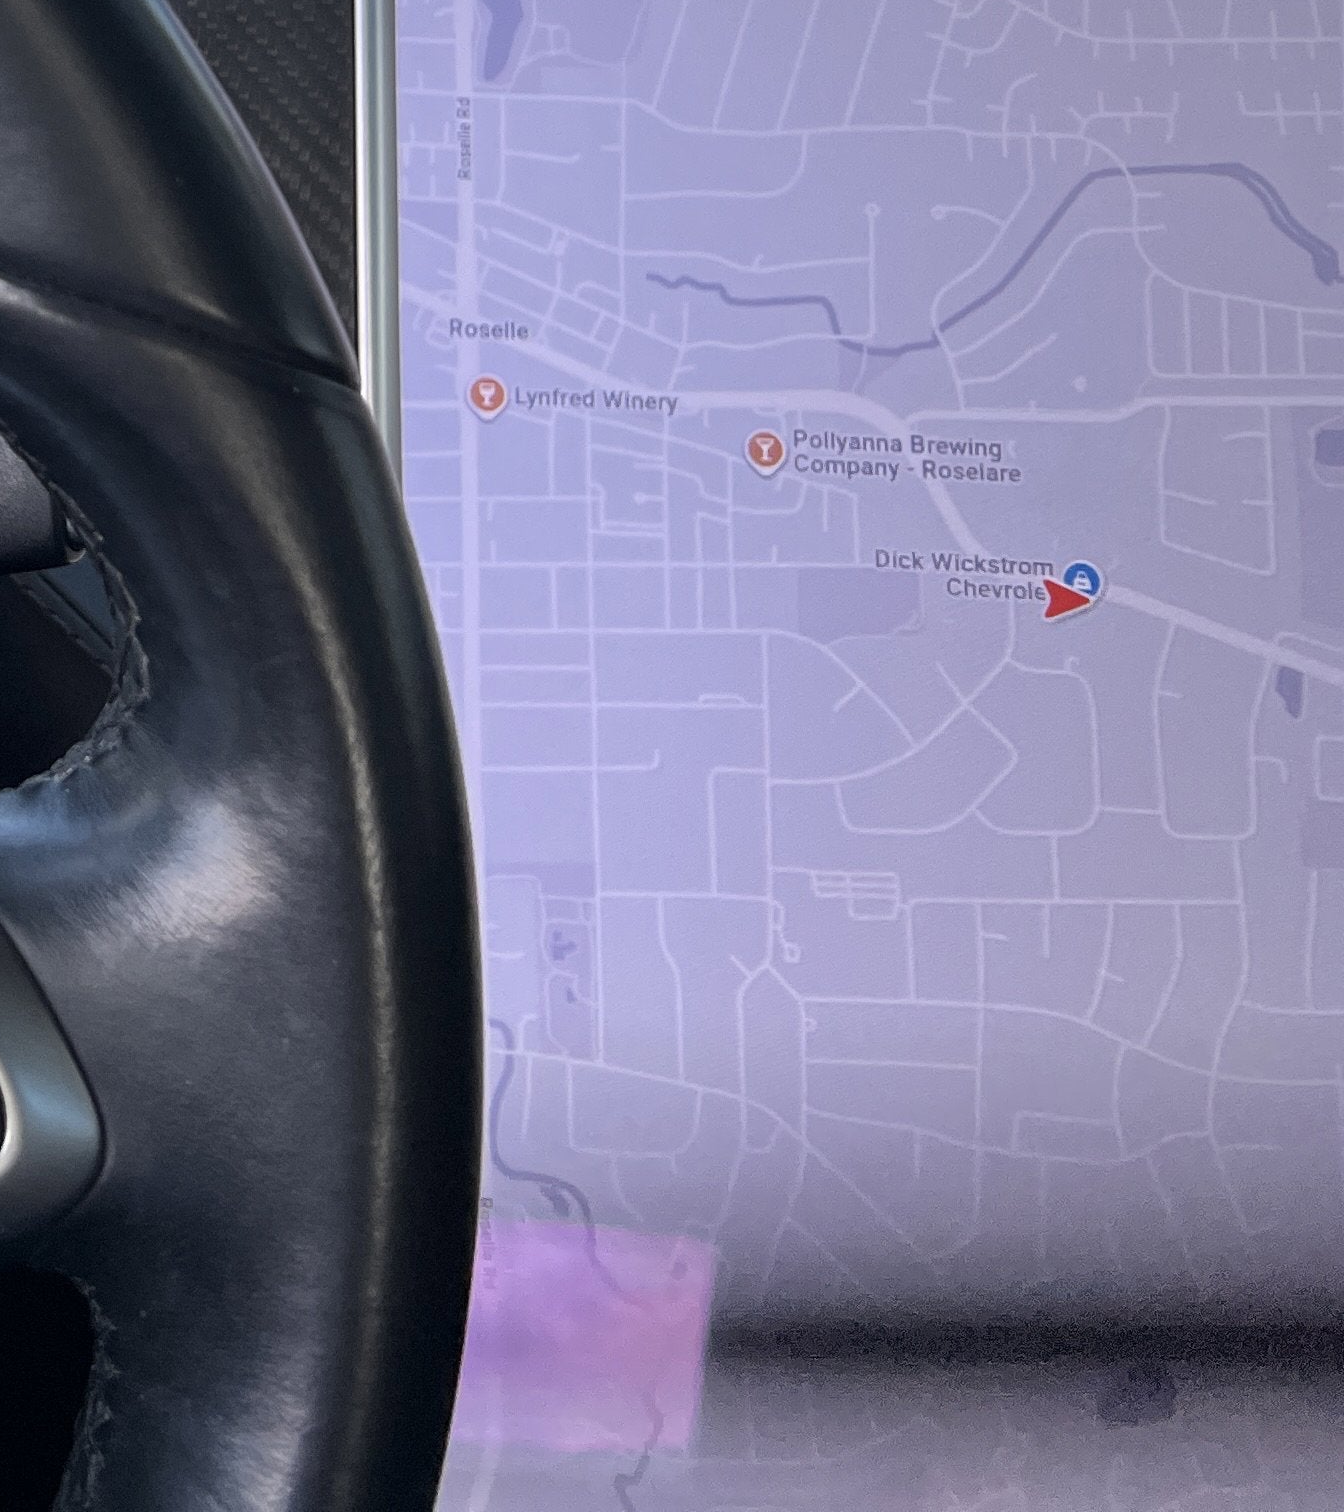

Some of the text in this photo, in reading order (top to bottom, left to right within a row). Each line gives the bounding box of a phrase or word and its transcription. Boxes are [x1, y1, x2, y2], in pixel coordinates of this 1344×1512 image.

[448, 317, 530, 340] Roselle
[515, 386, 679, 416] Lynfred Winery
[793, 429, 1002, 462] Pollyanna Brewing
[794, 454, 900, 482] Company
[921, 460, 1023, 483] Roselare
[874, 548, 1054, 576] Dick Wickstrom
[946, 576, 1047, 602] Chevrole
